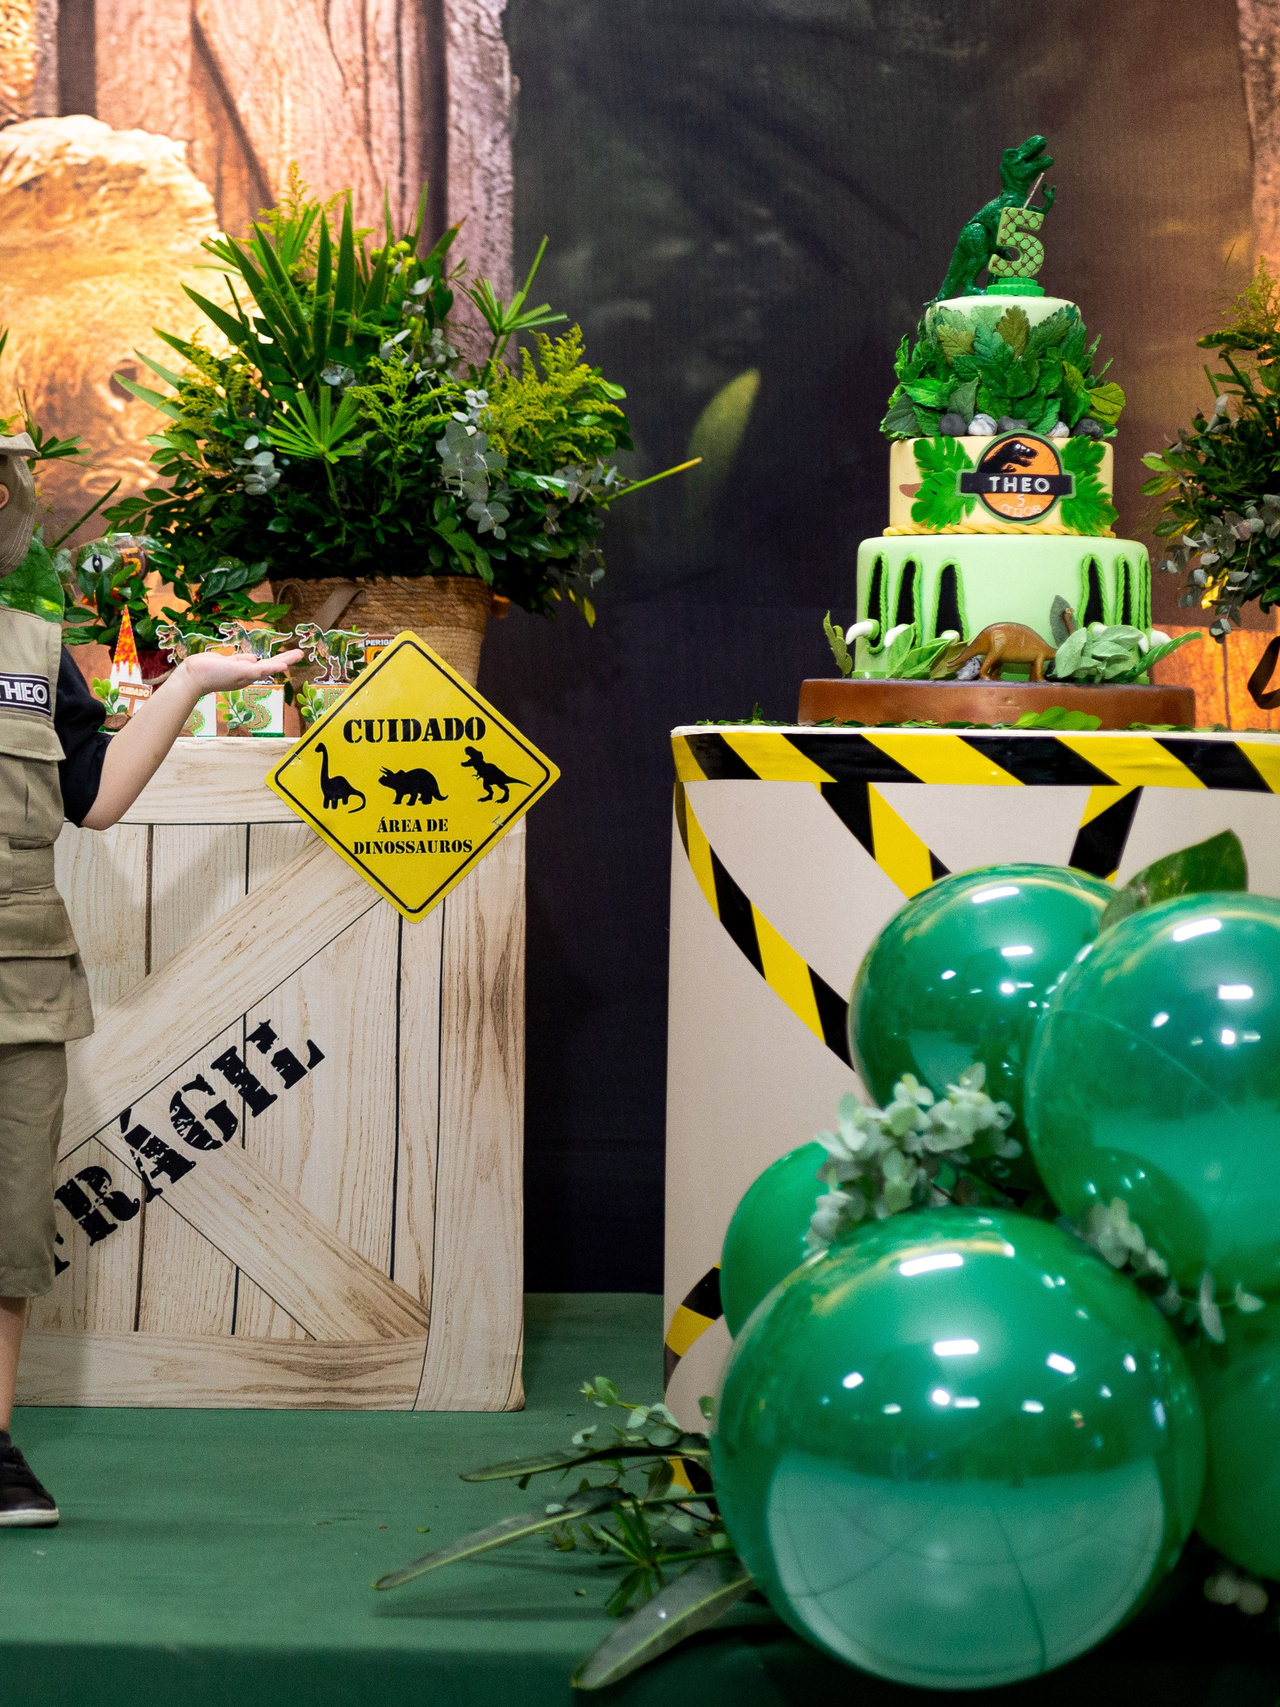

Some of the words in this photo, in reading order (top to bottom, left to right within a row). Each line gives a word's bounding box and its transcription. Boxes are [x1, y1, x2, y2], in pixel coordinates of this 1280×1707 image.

[988, 207, 1045, 278] 5
[989, 476, 1050, 493] THEO
[1017, 493, 1026, 508] 5
[365, 638, 395, 646] PERIG
[343, 716, 486, 744] CUIDADO
[377, 816, 423, 833] ÁREA
[426, 818, 449, 832] DE
[353, 839, 473, 855] DINOSSAUROS
